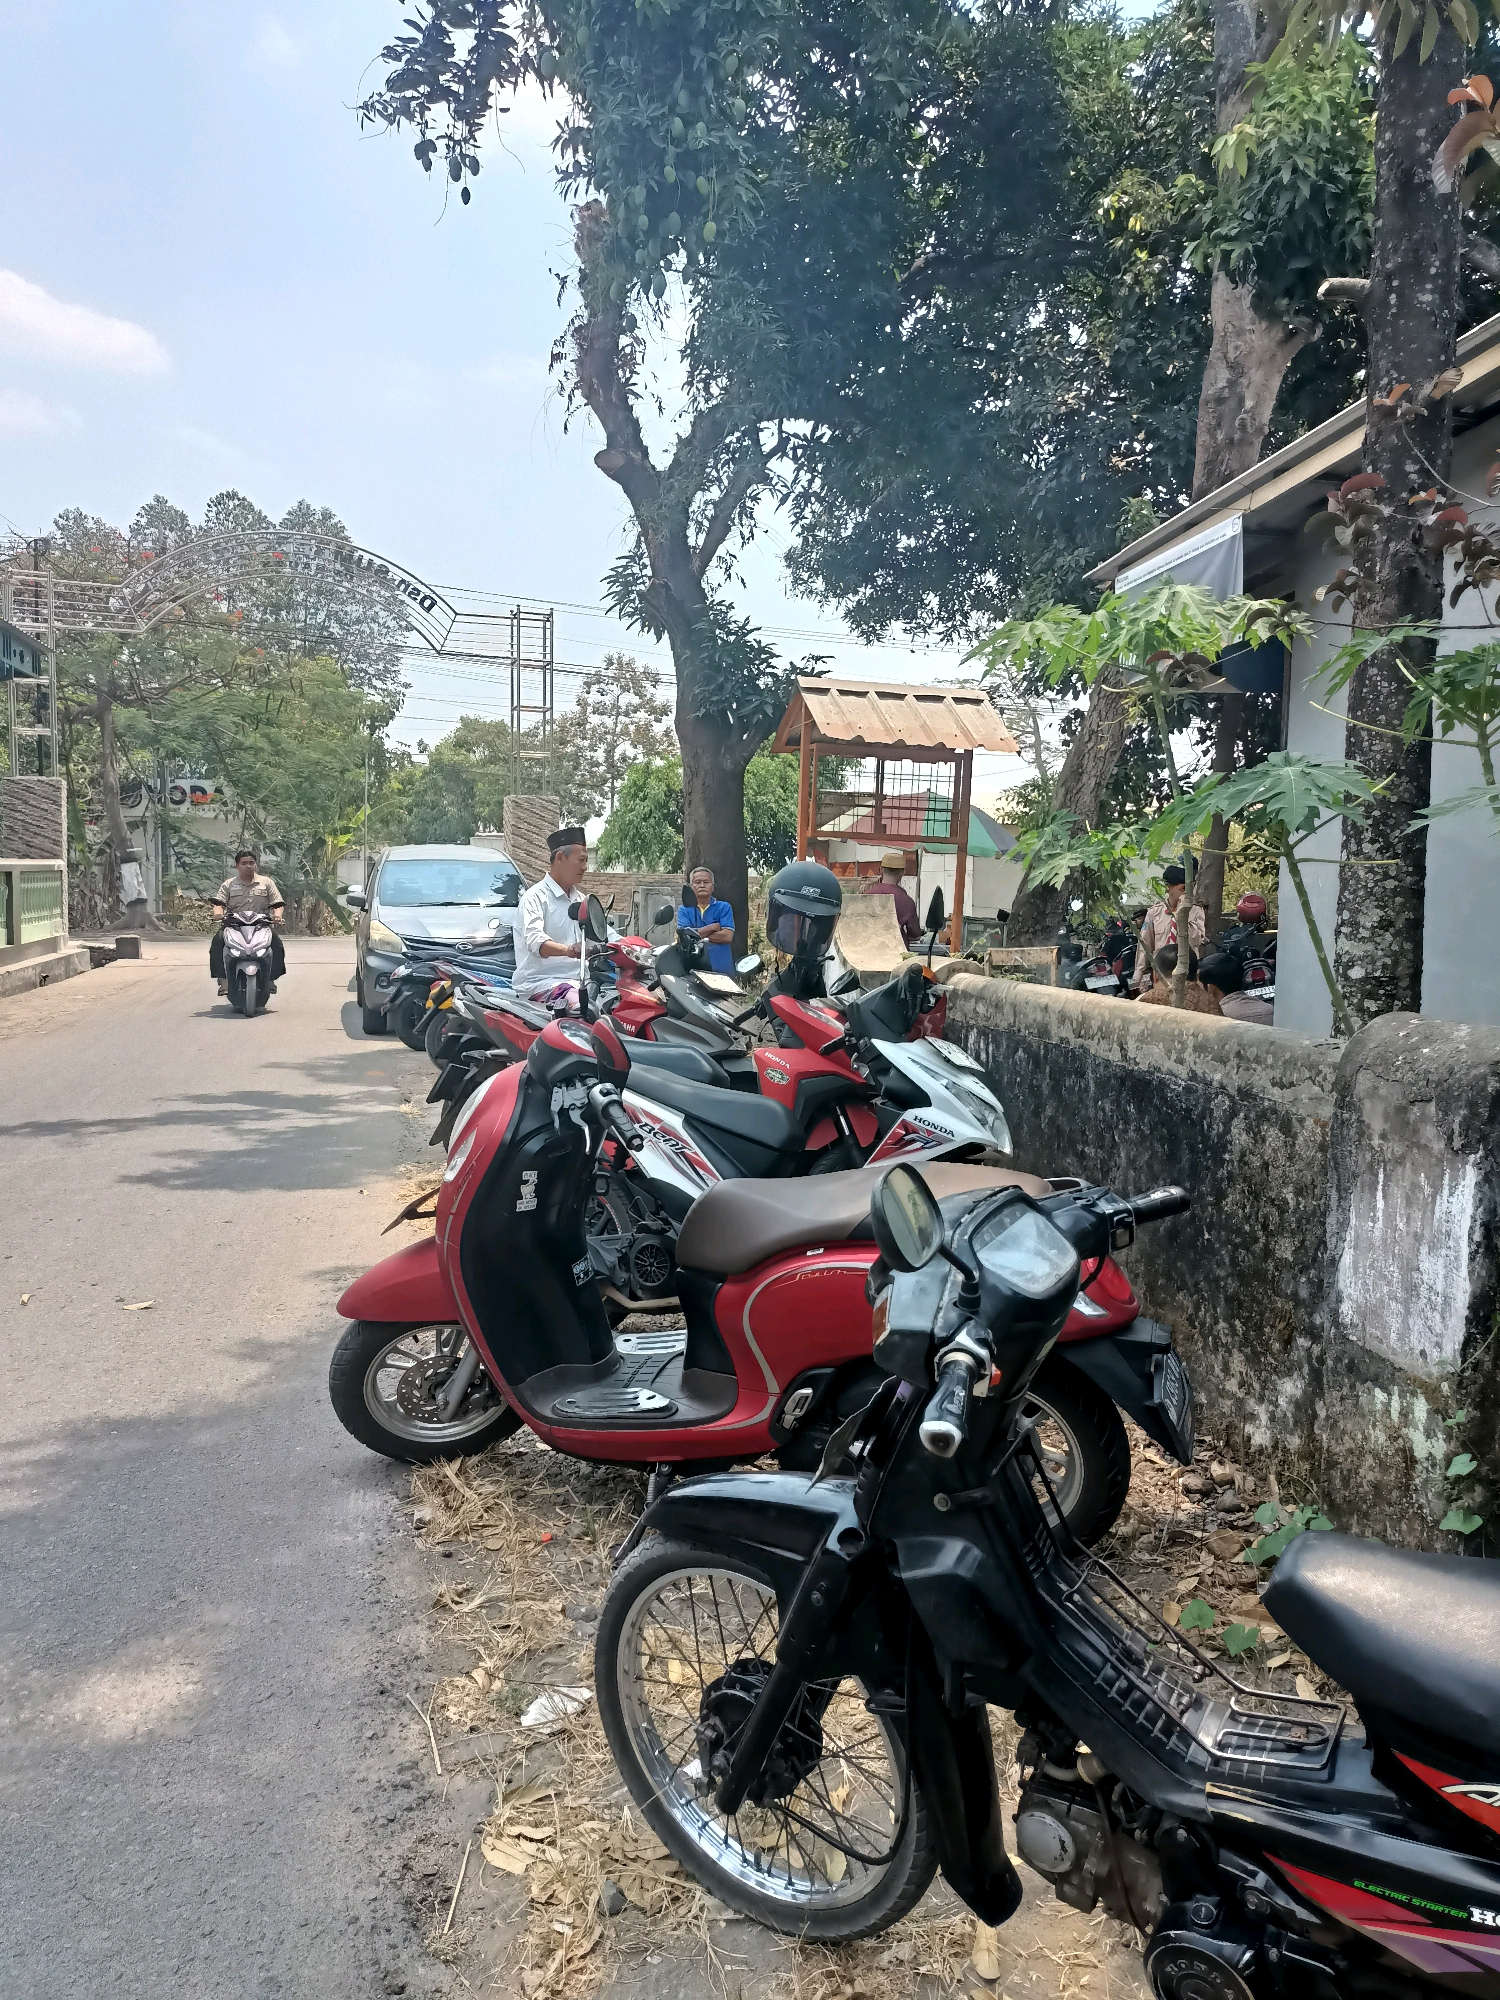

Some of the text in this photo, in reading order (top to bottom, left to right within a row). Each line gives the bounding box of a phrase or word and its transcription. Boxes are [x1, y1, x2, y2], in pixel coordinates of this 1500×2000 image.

[764, 1051, 790, 1070] HONDA
[912, 1114, 955, 1138] HONDA
[1353, 1880, 1500, 1927] ELECTRIC STARTER H
